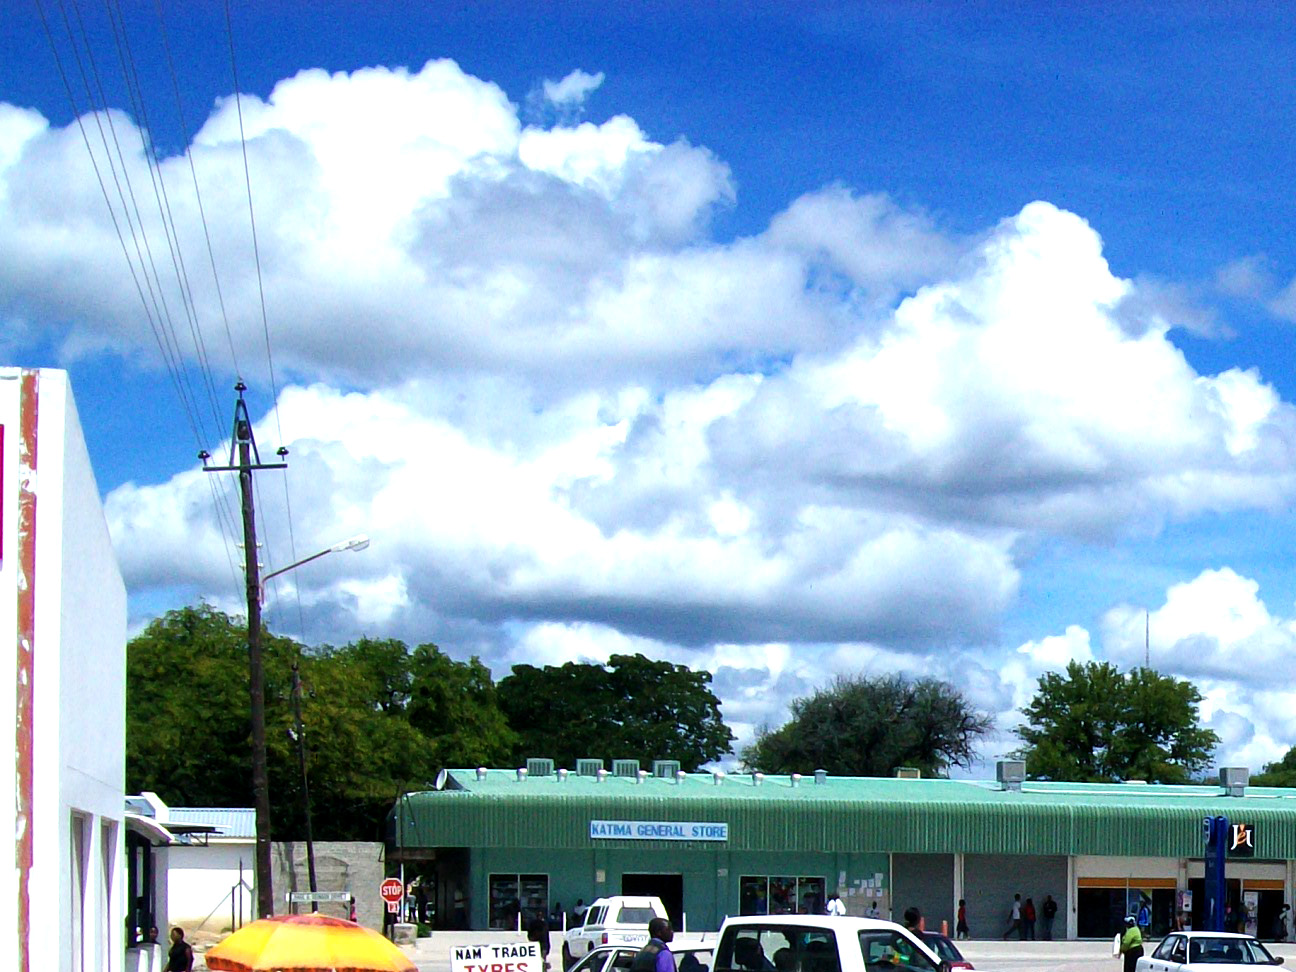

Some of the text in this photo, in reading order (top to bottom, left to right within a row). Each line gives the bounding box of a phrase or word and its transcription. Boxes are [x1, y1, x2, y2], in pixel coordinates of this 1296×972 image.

[591, 823, 727, 838] KATIMA GENERAL STORE
[382, 885, 402, 896] STOP
[455, 945, 537, 961] NAM TRADE
